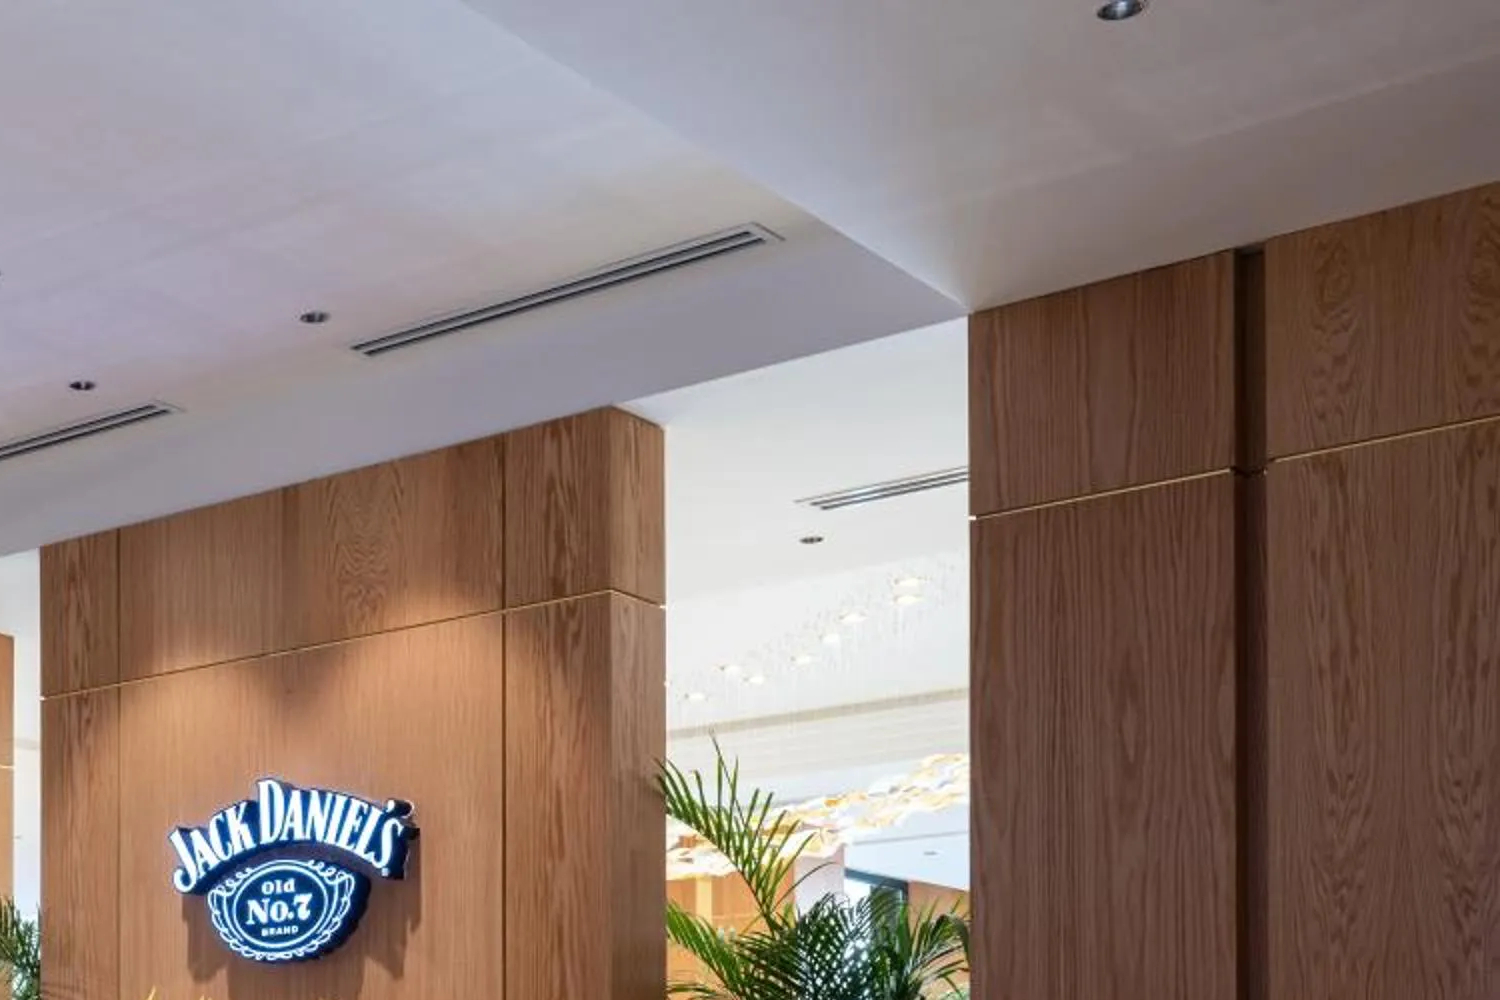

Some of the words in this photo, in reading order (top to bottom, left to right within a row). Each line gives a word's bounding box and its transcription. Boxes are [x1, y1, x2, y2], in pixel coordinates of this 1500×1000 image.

[169, 802, 256, 892] JACK
[257, 779, 403, 869] DANIEL'S
[261, 878, 296, 895] Old
[261, 925, 299, 937] BRAND
